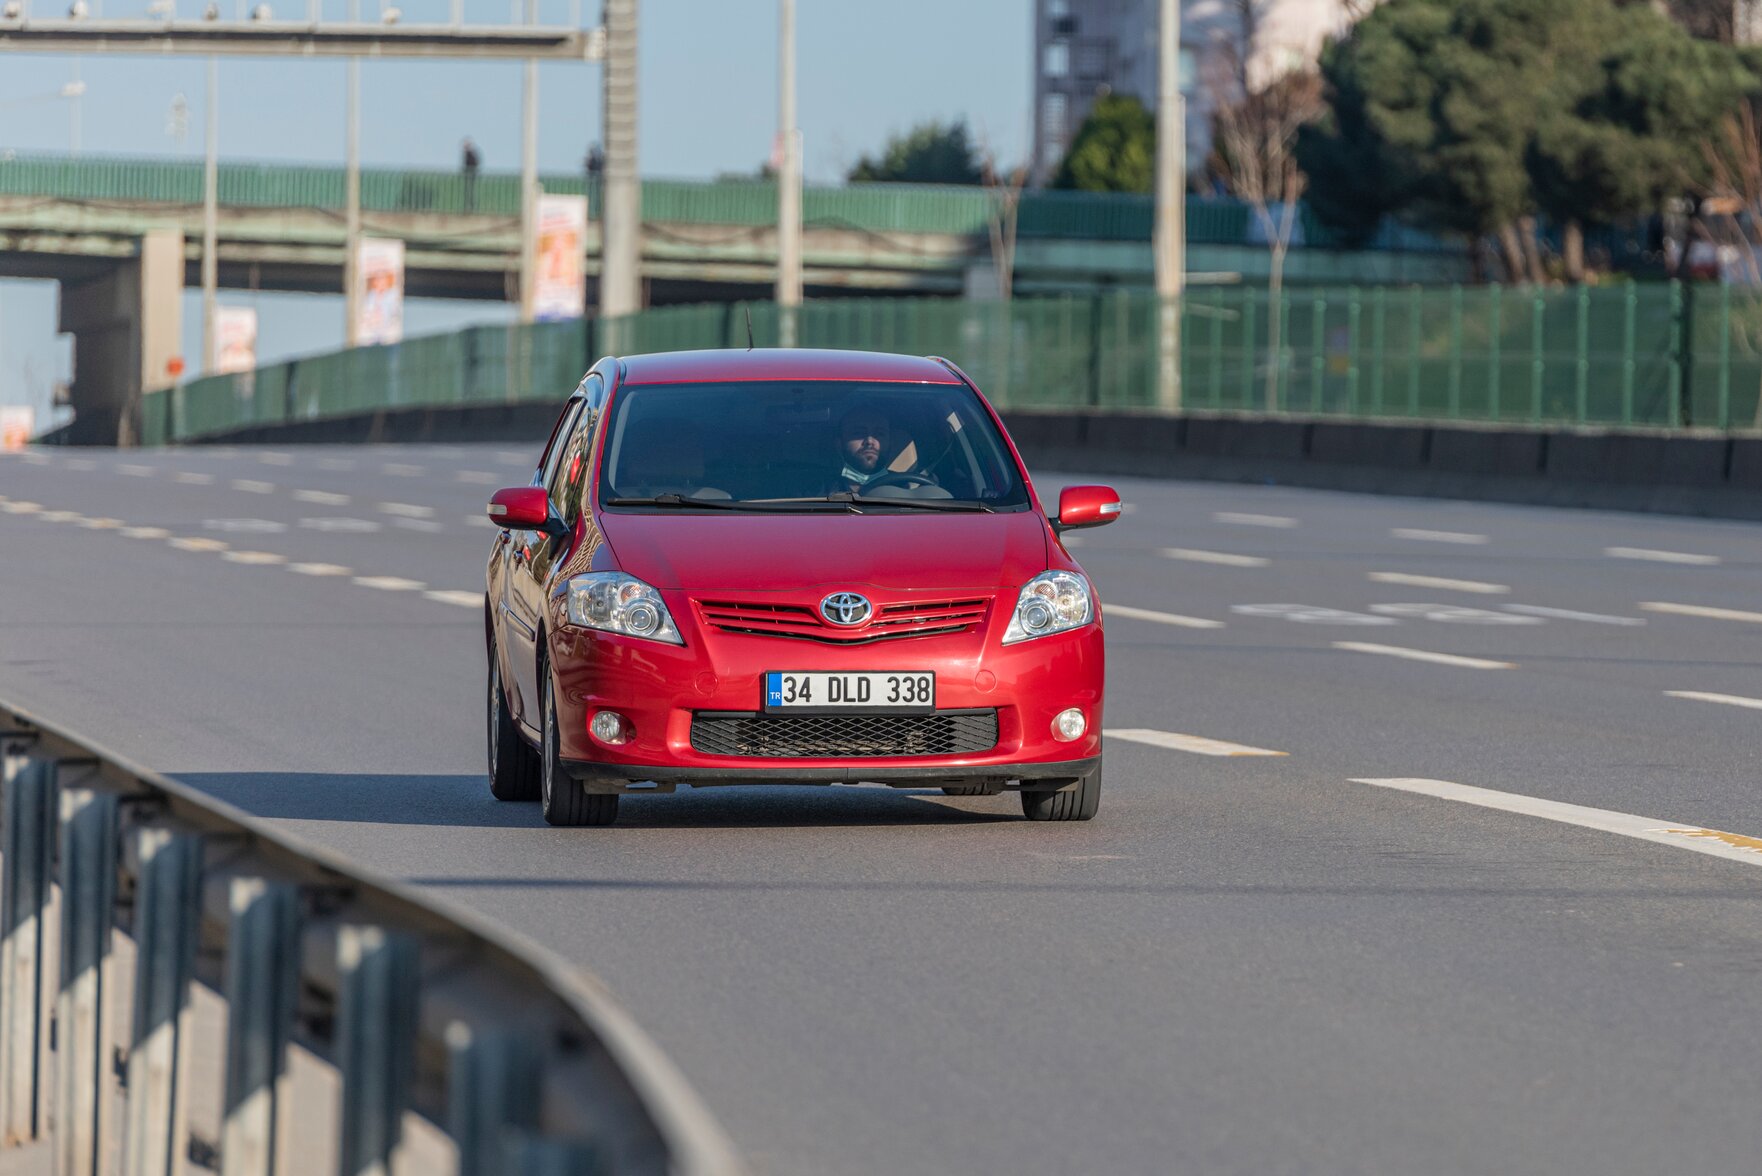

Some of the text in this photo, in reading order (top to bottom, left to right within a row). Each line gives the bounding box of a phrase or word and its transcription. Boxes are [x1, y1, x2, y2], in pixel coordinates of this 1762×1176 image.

[770, 676, 930, 703] TR 34 DLD 338
